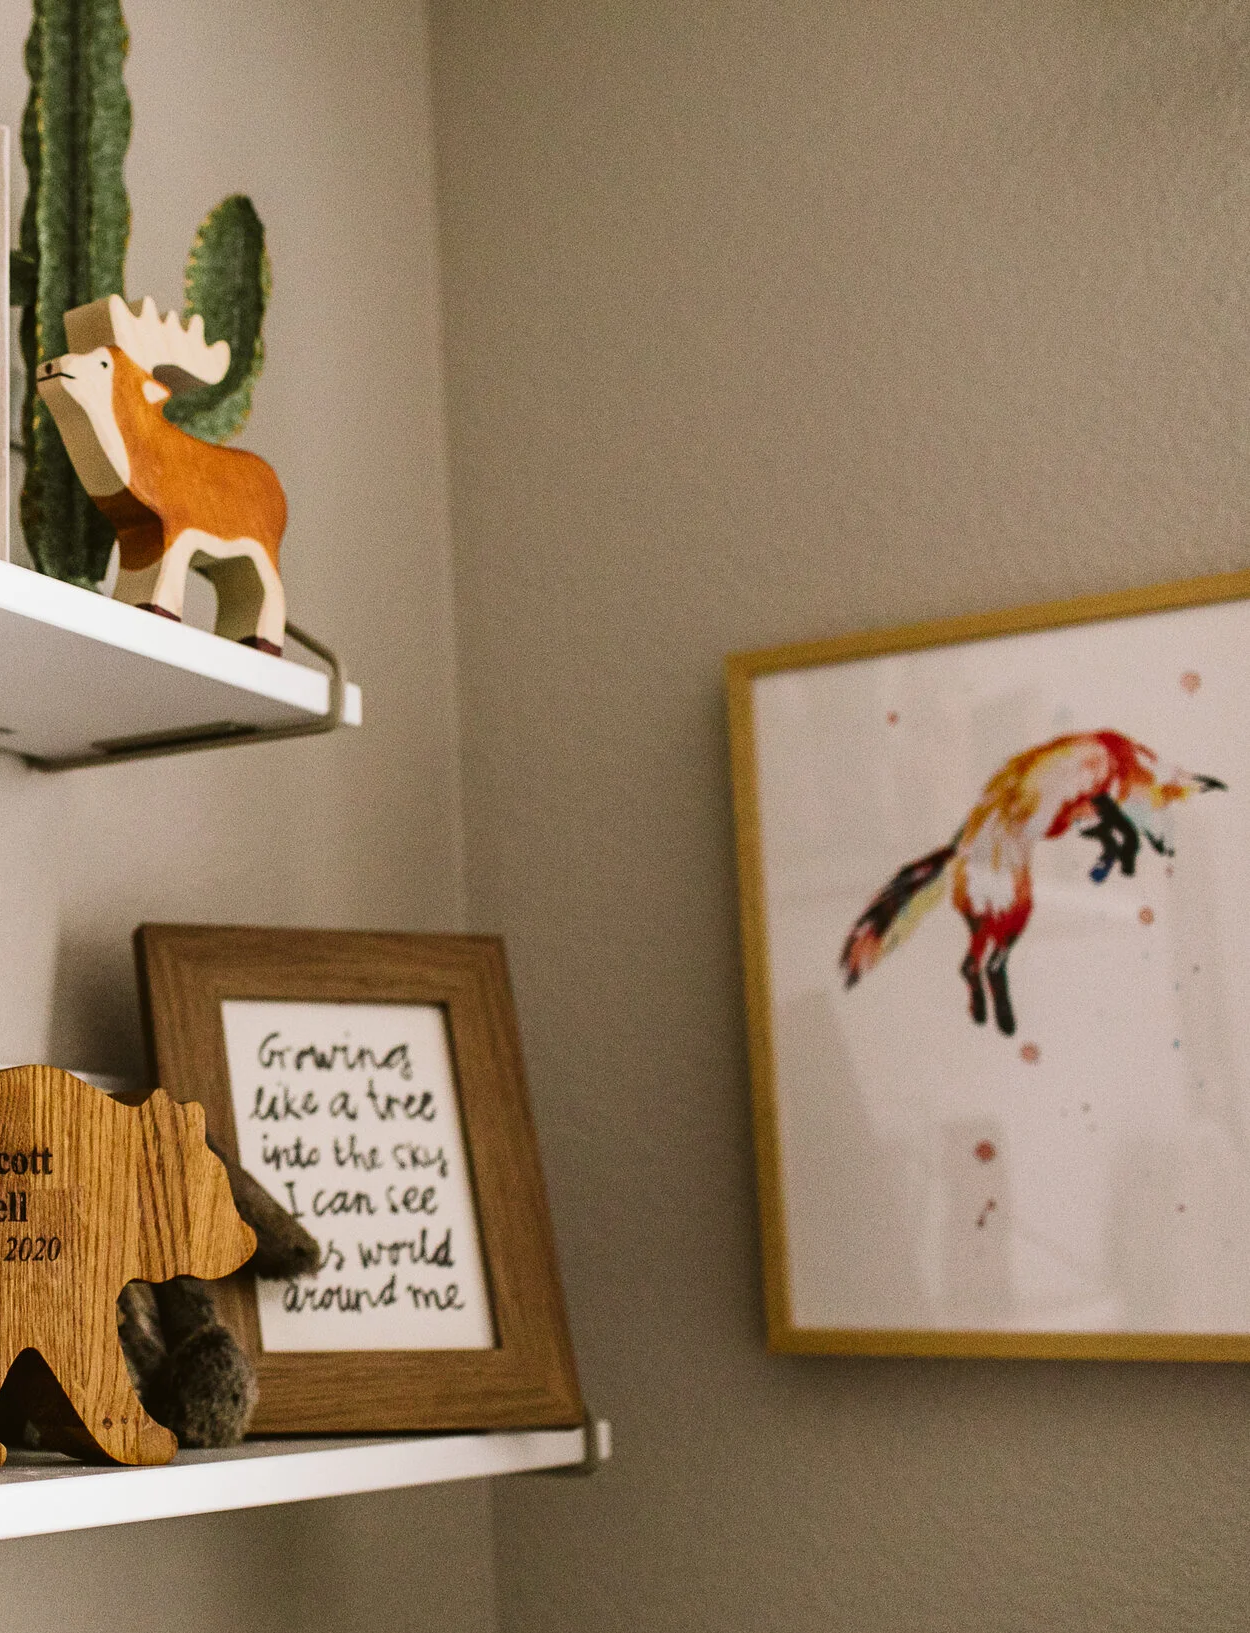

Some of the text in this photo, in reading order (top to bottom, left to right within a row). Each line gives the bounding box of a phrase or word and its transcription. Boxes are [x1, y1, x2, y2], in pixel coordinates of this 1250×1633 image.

[258, 1031, 413, 1080] Growing
[250, 1077, 436, 1121] like a tree
[262, 1134, 448, 1178] into the sky
[285, 1181, 440, 1217] I can see
[4, 1237, 61, 1262] 2020
[358, 1227, 454, 1268] world
[283, 1273, 464, 1313] around me
